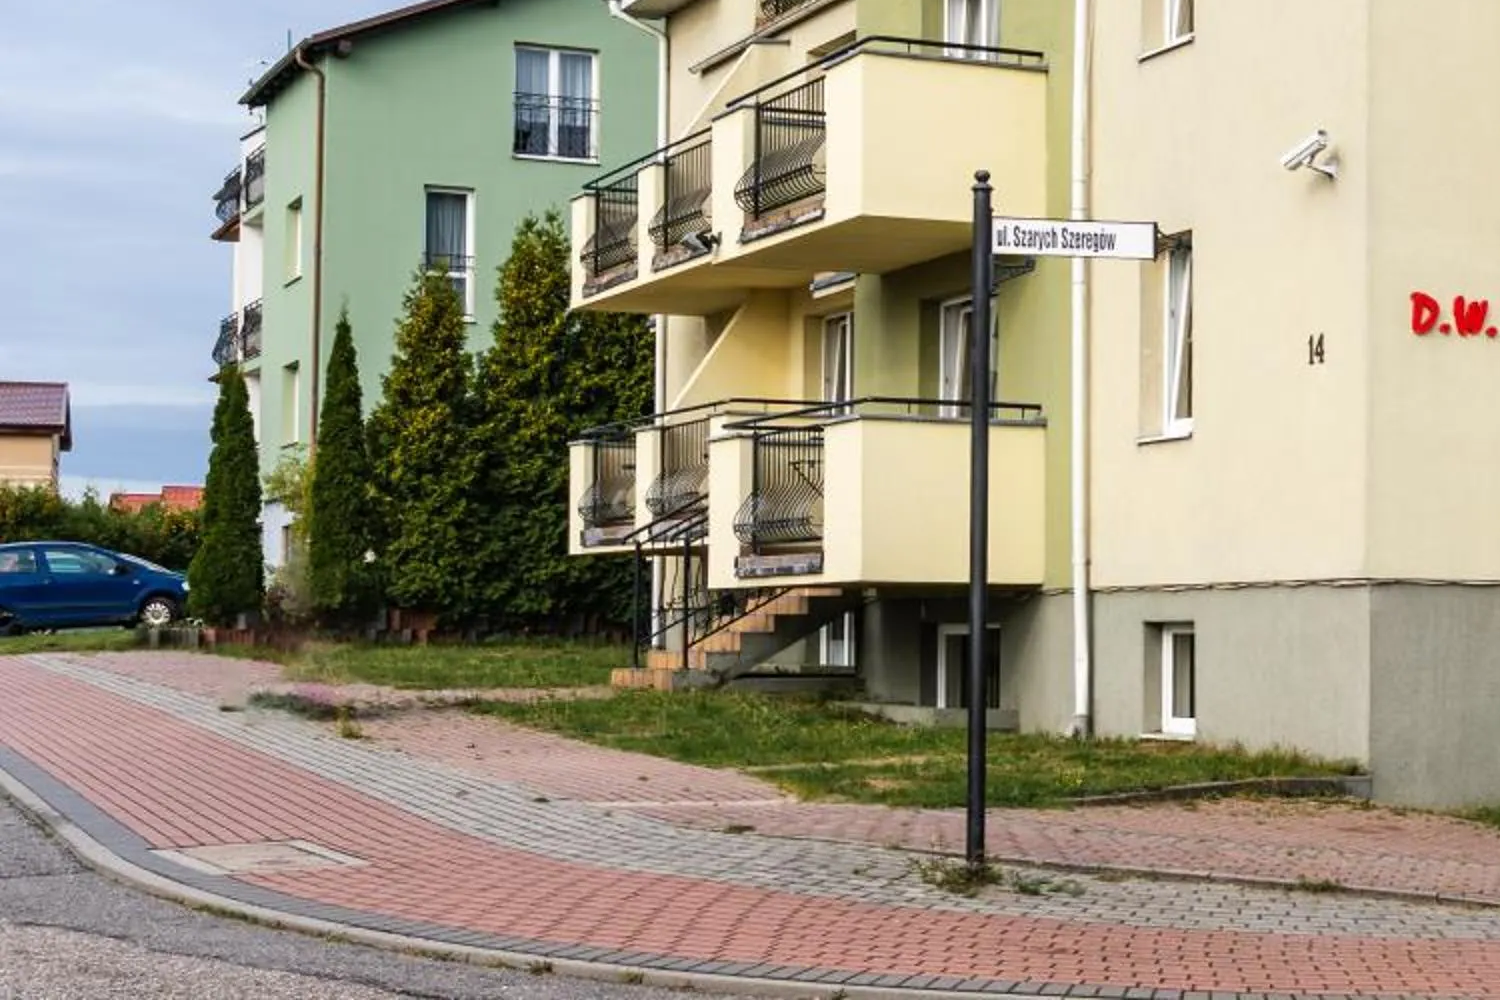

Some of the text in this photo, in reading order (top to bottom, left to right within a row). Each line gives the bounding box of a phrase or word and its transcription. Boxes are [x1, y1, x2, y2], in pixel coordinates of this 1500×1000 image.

[997, 225, 1116, 252] ul. Szarych Szeregów
[1410, 291, 1499, 337] D.W.
[1308, 334, 1325, 365] 14
